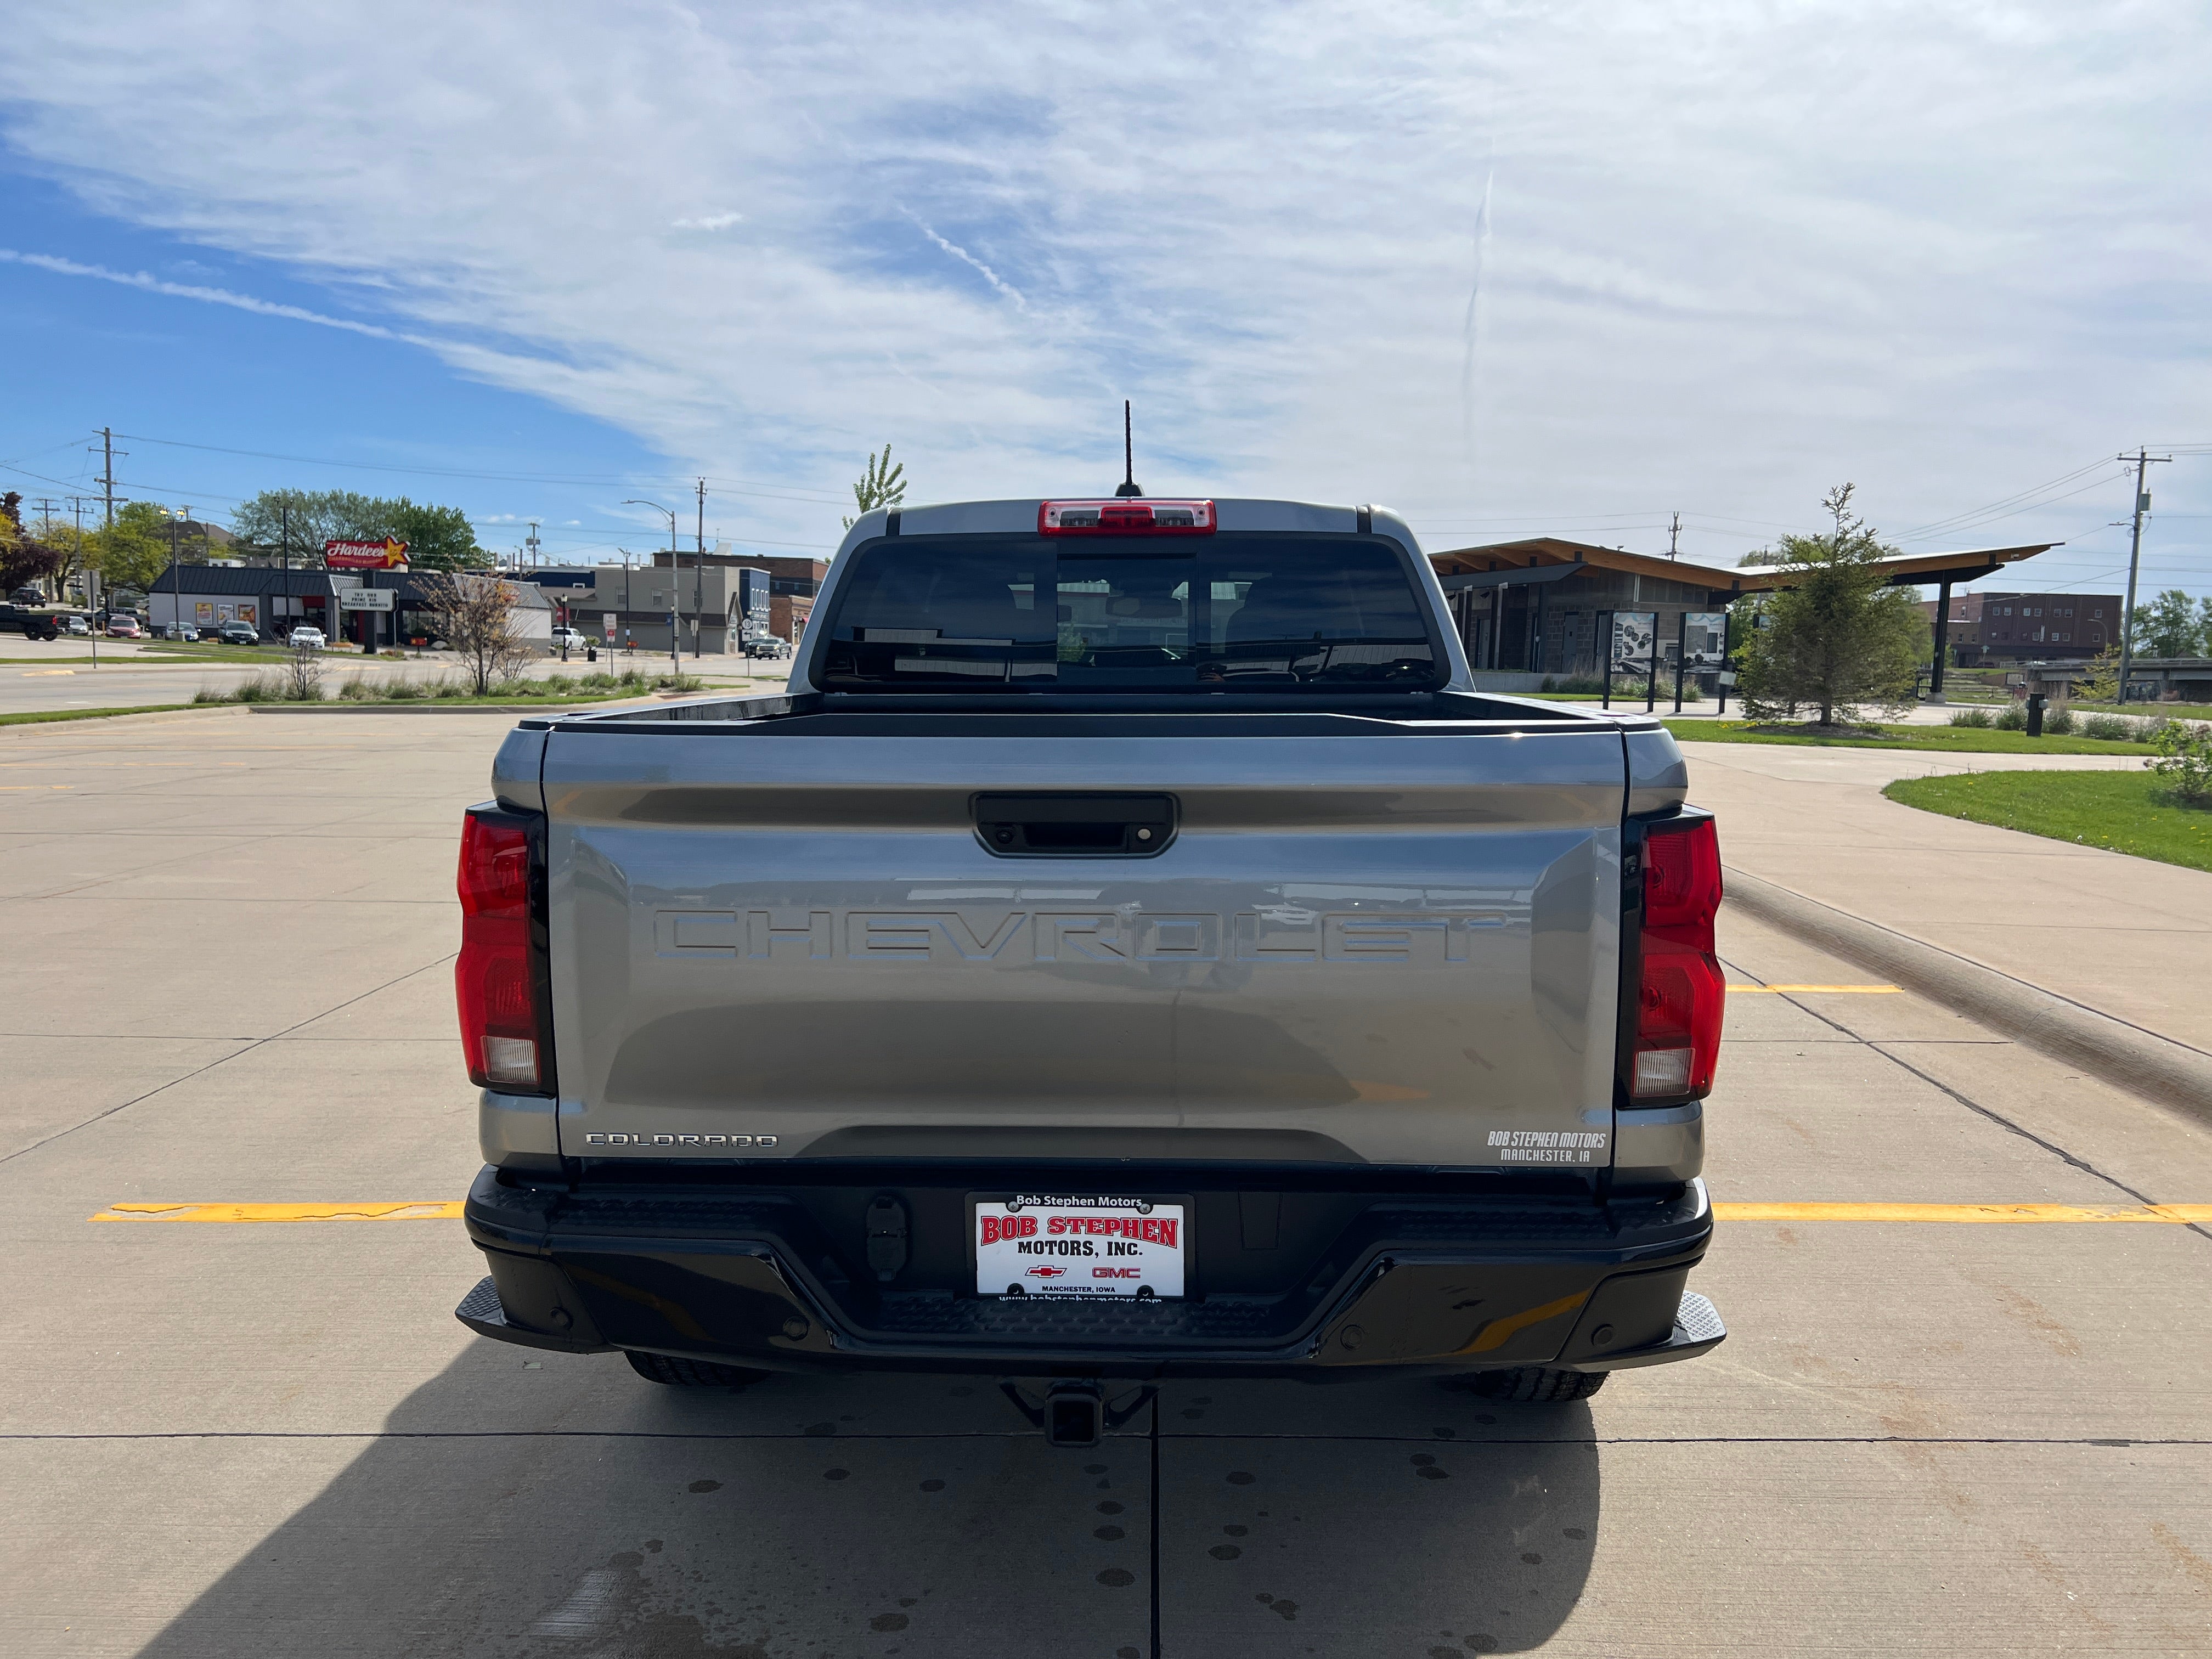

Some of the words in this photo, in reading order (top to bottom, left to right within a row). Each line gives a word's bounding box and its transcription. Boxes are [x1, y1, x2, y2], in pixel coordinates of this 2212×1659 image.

[328, 543, 385, 557] Hardee's
[653, 909, 1506, 962] CHEVROLET
[585, 1132, 779, 1148] COLORADO
[1487, 1131, 1510, 1146] BOB
[1511, 1131, 1558, 1147] STEPHEN
[1559, 1132, 1606, 1148] MOTORS
[1579, 1150, 1590, 1162] IA
[1017, 1195, 1041, 1206] Bob
[1044, 1195, 1096, 1207] Stephen
[1098, 1197, 1142, 1207] Motors
[980, 1216, 1037, 1246] BOB
[1047, 1216, 1178, 1249] STEPHEN
[1018, 1240, 1099, 1258] MOTORS,
[1107, 1242, 1143, 1256] INC.
[1092, 1267, 1141, 1279] GMC
[1041, 1285, 1094, 1294] MANCHESTER,
[999, 1294, 1162, 1303] wwwbobstephenmotorscom
